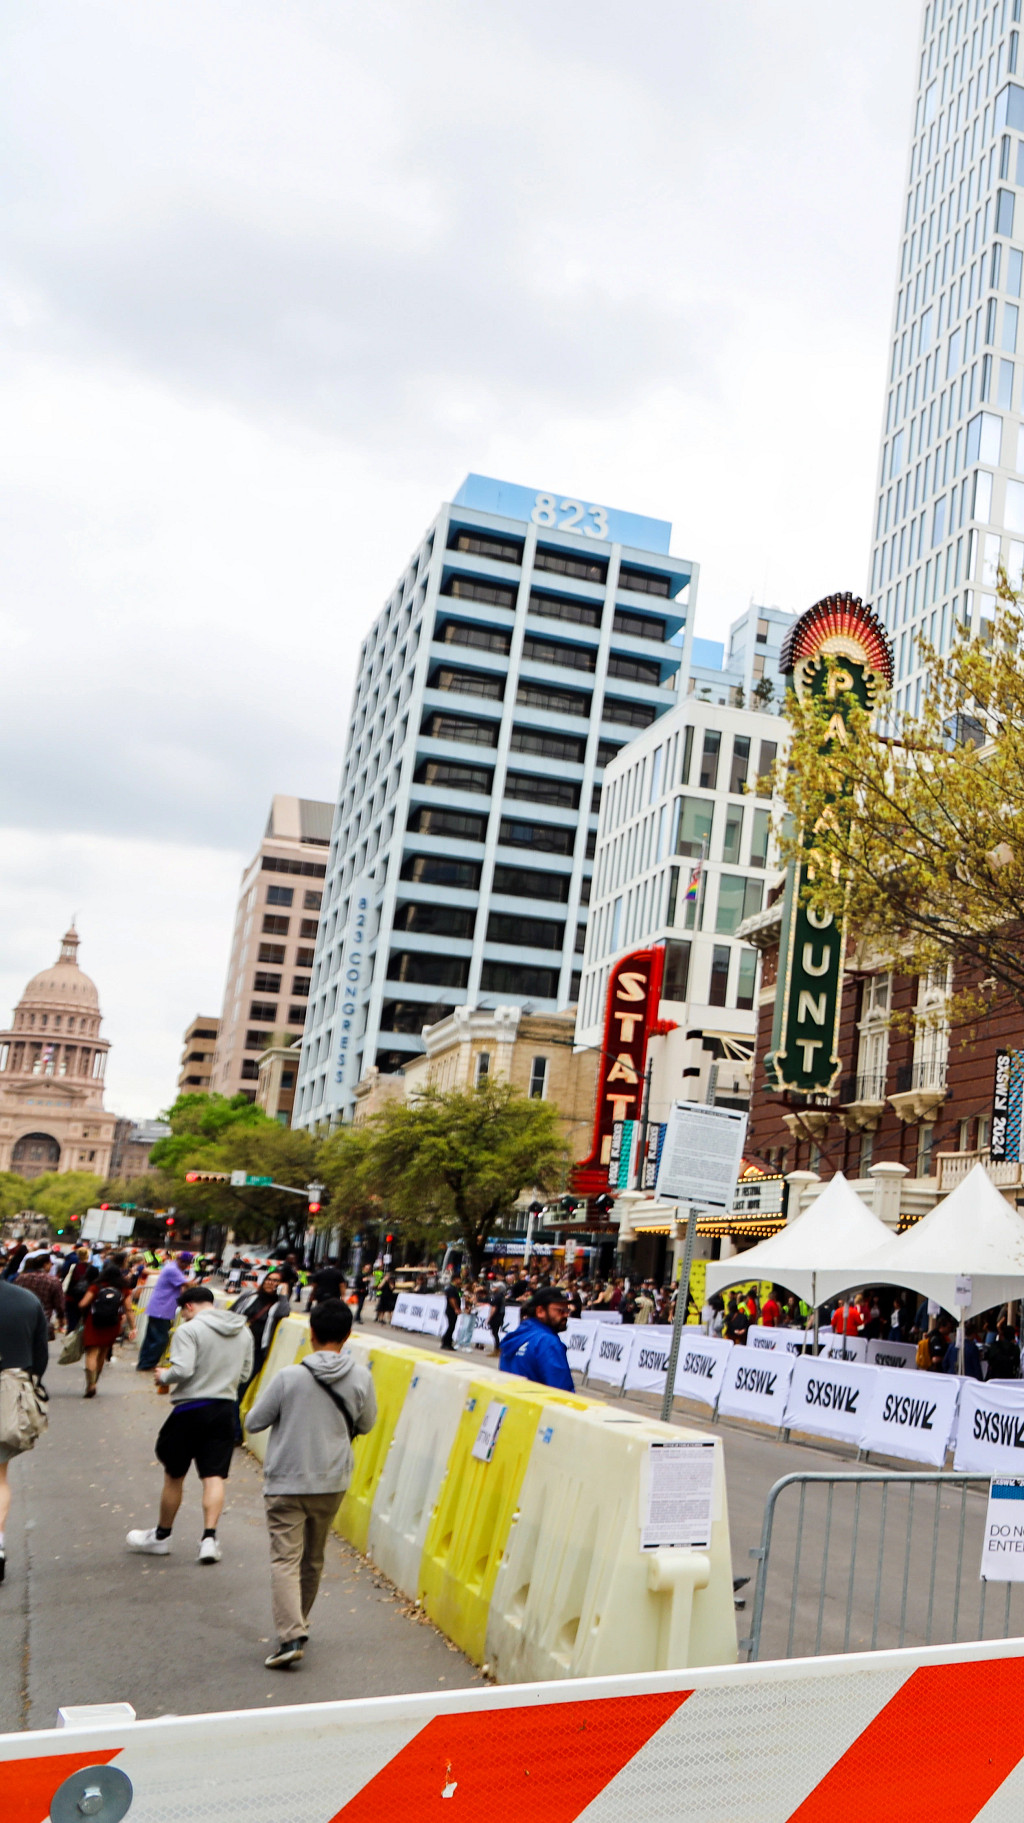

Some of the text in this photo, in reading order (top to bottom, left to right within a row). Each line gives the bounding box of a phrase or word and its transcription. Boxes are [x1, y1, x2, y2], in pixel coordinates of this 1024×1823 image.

[531, 493, 609, 540] 823
[796, 668, 854, 1073] PAAMOUNT
[335, 898, 367, 1084] 823 CONGRESS
[992, 1055, 1010, 1155] SXSW 2024
[599, 1340, 619, 1360] SXSW
[638, 1349, 664, 1370] SXSW
[683, 1352, 709, 1375] SXSW
[735, 1368, 771, 1394] SXSW
[805, 1379, 849, 1410] SXSW
[883, 1393, 925, 1426] SXSW
[973, 1409, 1016, 1447] SXSW
[990, 1524, 1011, 1537] DO
